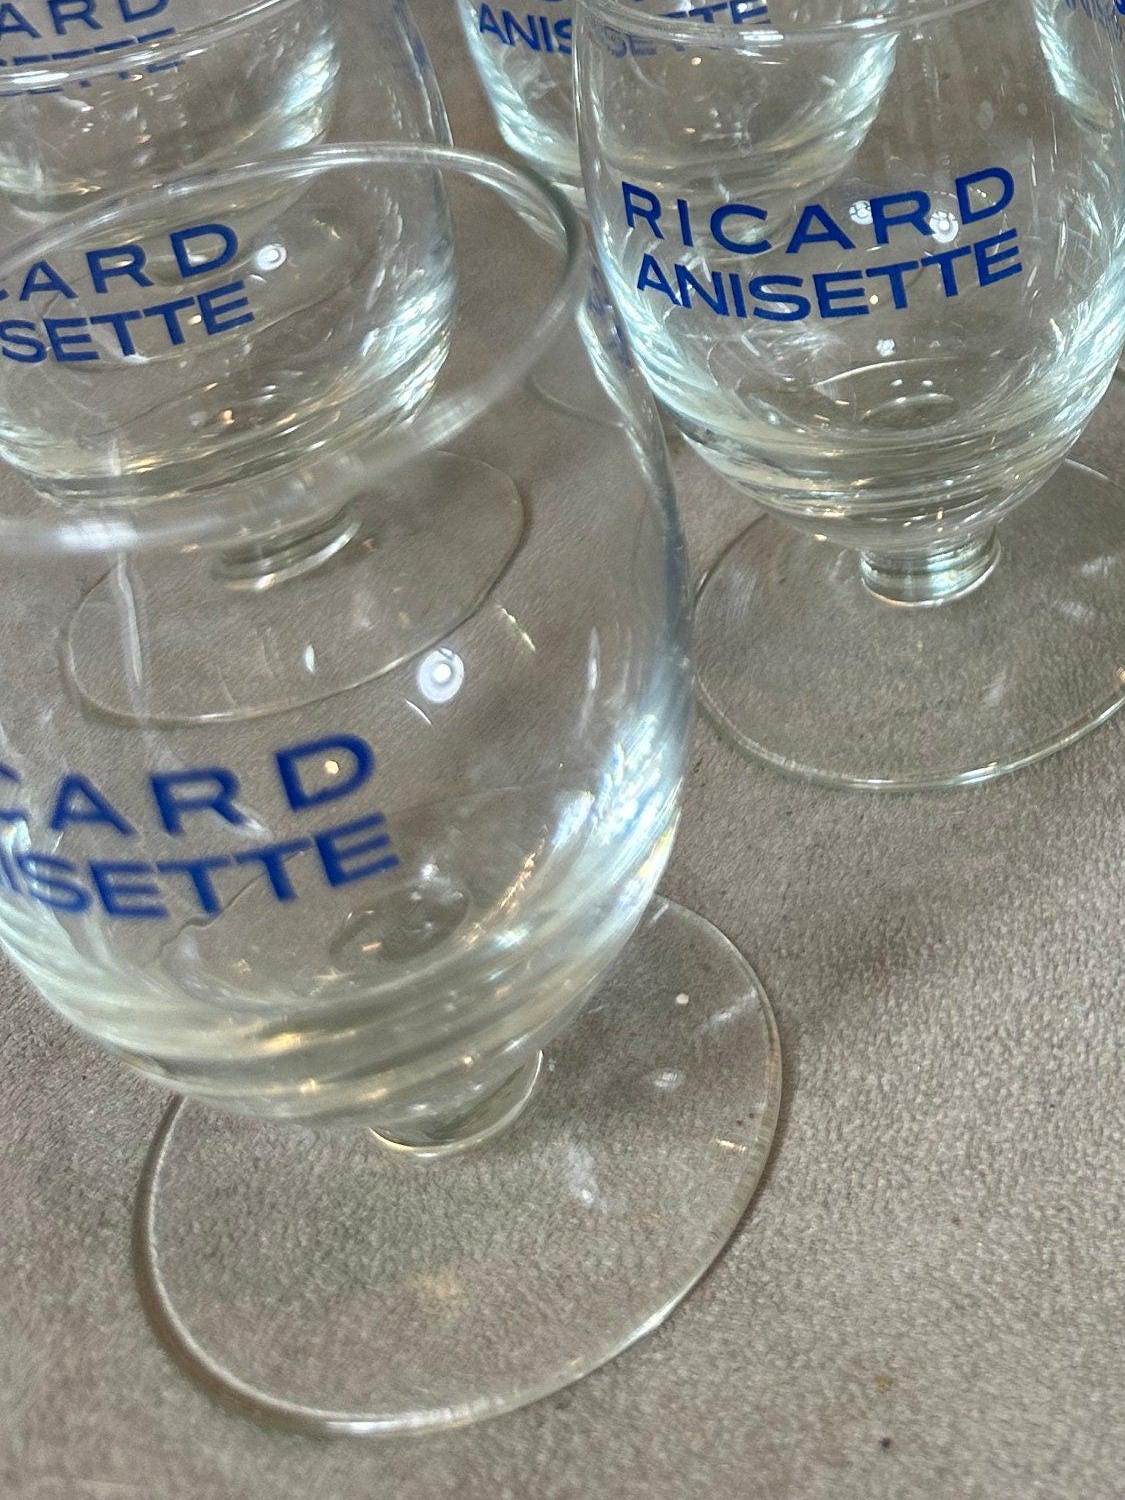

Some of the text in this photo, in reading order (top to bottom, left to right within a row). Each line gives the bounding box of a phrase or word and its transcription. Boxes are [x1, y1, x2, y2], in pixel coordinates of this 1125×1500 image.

[621, 167, 1015, 255] RICARD
[0, 224, 238, 300] ARD
[636, 228, 1023, 322] ANISETTE
[0, 734, 375, 836] ARD
